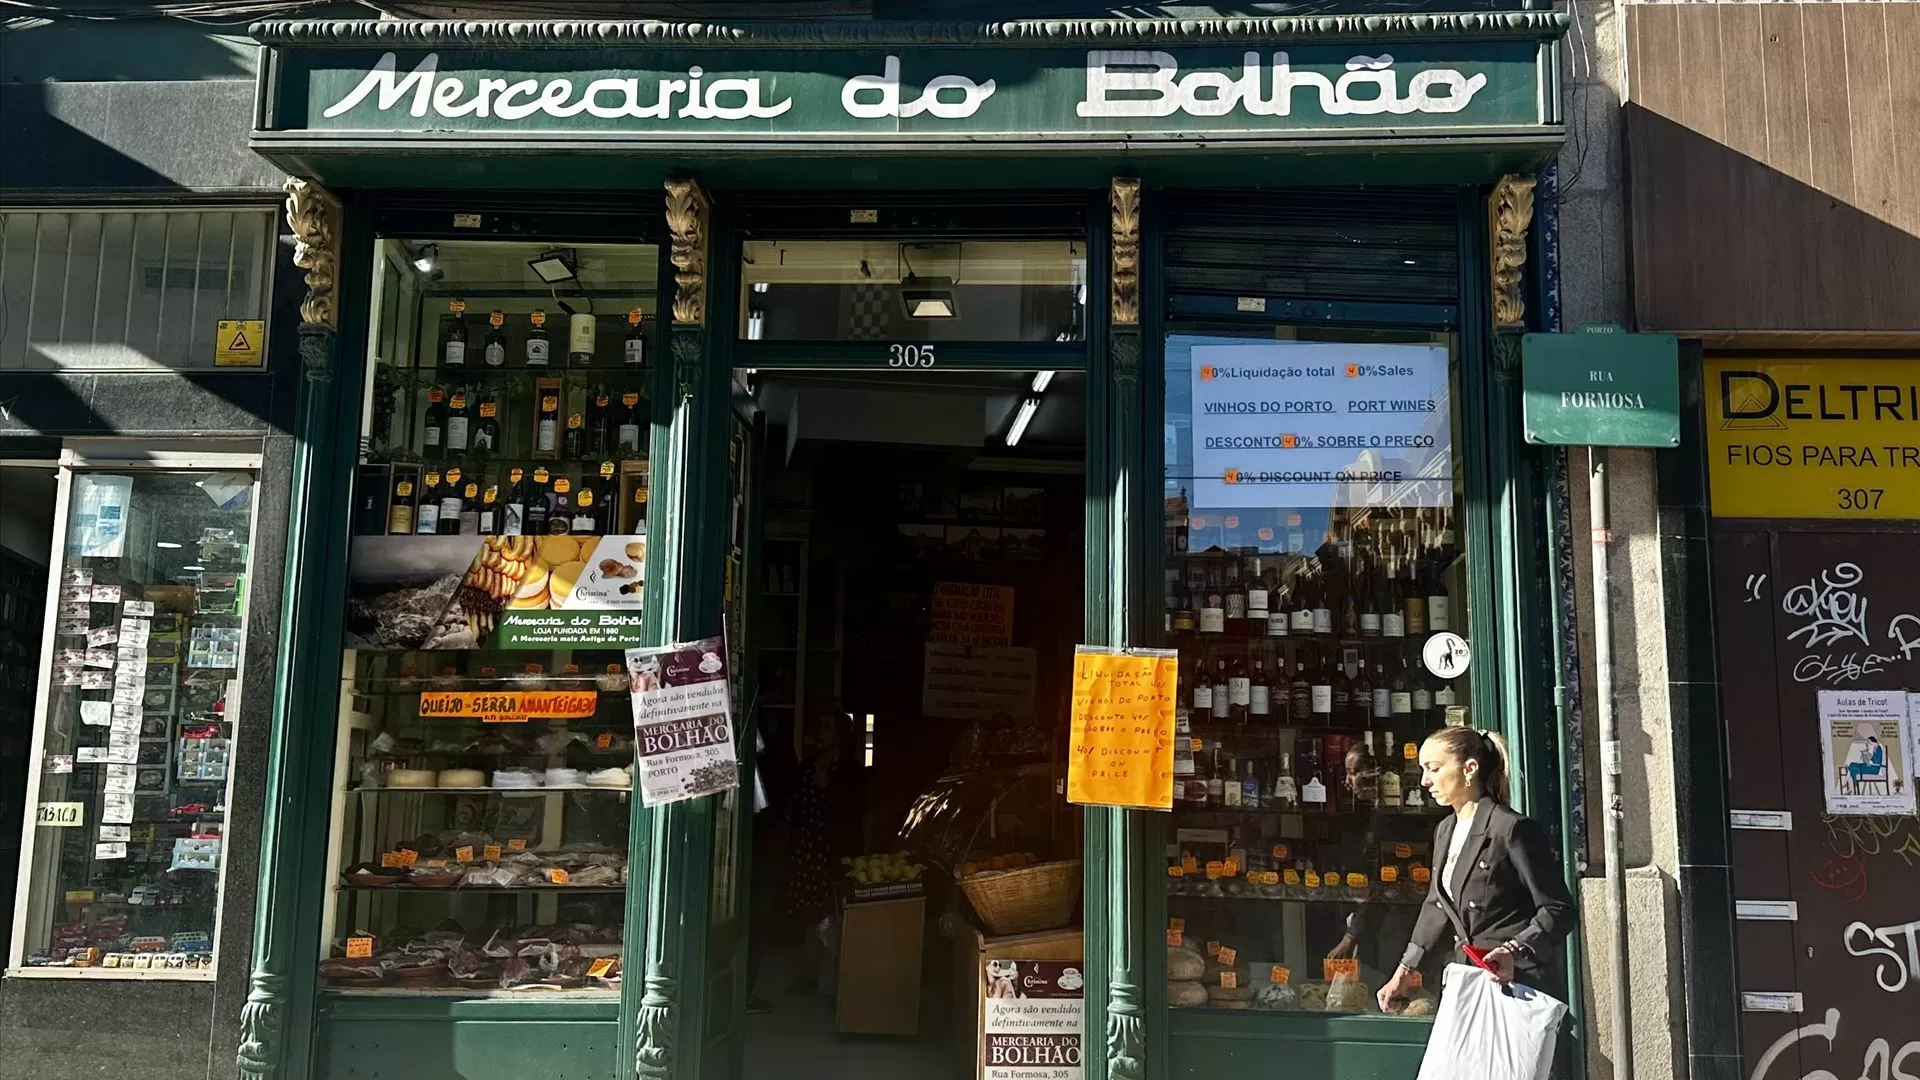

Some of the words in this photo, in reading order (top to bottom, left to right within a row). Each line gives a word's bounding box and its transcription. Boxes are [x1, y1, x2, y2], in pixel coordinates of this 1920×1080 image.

[323, 52, 792, 120] Mercearia
[841, 54, 995, 119] do
[1076, 49, 1487, 118] Bolhão
[889, 344, 934, 367] 305
[1306, 366, 1335, 377] total
[1590, 370, 1613, 382] RUA
[1349, 400, 1386, 411] PORT
[1388, 400, 1436, 411] WINES
[1561, 392, 1644, 409] FORMOSA
[1204, 402, 1256, 413] VINHOS
[1261, 401, 1280, 412] DO
[1285, 401, 1333, 412] PORTO
[1318, 435, 1365, 447] SOBRE
[1370, 435, 1380, 447] O
[1385, 435, 1434, 448] PREÇO
[1728, 445, 1792, 466] FIOS
[1803, 446, 1877, 467] PARA
[1260, 472, 1331, 483] DISCOUNT
[1336, 472, 1355, 482] ON
[1363, 471, 1401, 482] PRICE
[1838, 489, 1884, 510] 307
[504, 615, 564, 625] Mercearia
[571, 616, 591, 625] do
[1109, 680, 1141, 688] TOTAL
[641, 695, 667, 707] Agora
[671, 693, 684, 701] são
[687, 686, 724, 699] vendidos
[1137, 694, 1170, 702] PORTO
[1836, 697, 1856, 706] Aulas
[1858, 698, 1866, 706] de
[1868, 697, 1888, 706] Tricot
[421, 695, 462, 714] QUEIJO
[472, 695, 516, 713] SERRA
[640, 702, 709, 719] definitivamente
[711, 700, 722, 708] na
[643, 719, 703, 737] MERCEARIA
[709, 716, 724, 726] DO
[1135, 727, 1167, 737] PREÇO
[646, 757, 663, 767] Rua
[705, 748, 720, 758] 305
[1101, 747, 1162, 756] DISCOUNT
[648, 766, 678, 778] PORTO
[992, 1004, 1021, 1015] Agora
[1023, 1004, 1038, 1014] são
[1041, 1004, 1081, 1014] vendidos
[992, 1017, 1063, 1028] definitivamente
[992, 1037, 1054, 1046] MERCEARIA
[1062, 1037, 1078, 1046] DO
[992, 1045, 1081, 1064] BOLHÃO
[992, 1070, 1009, 1079] Rua
[1011, 1070, 1050, 1080] Formosa,
[1053, 1070, 1069, 1079] 305
